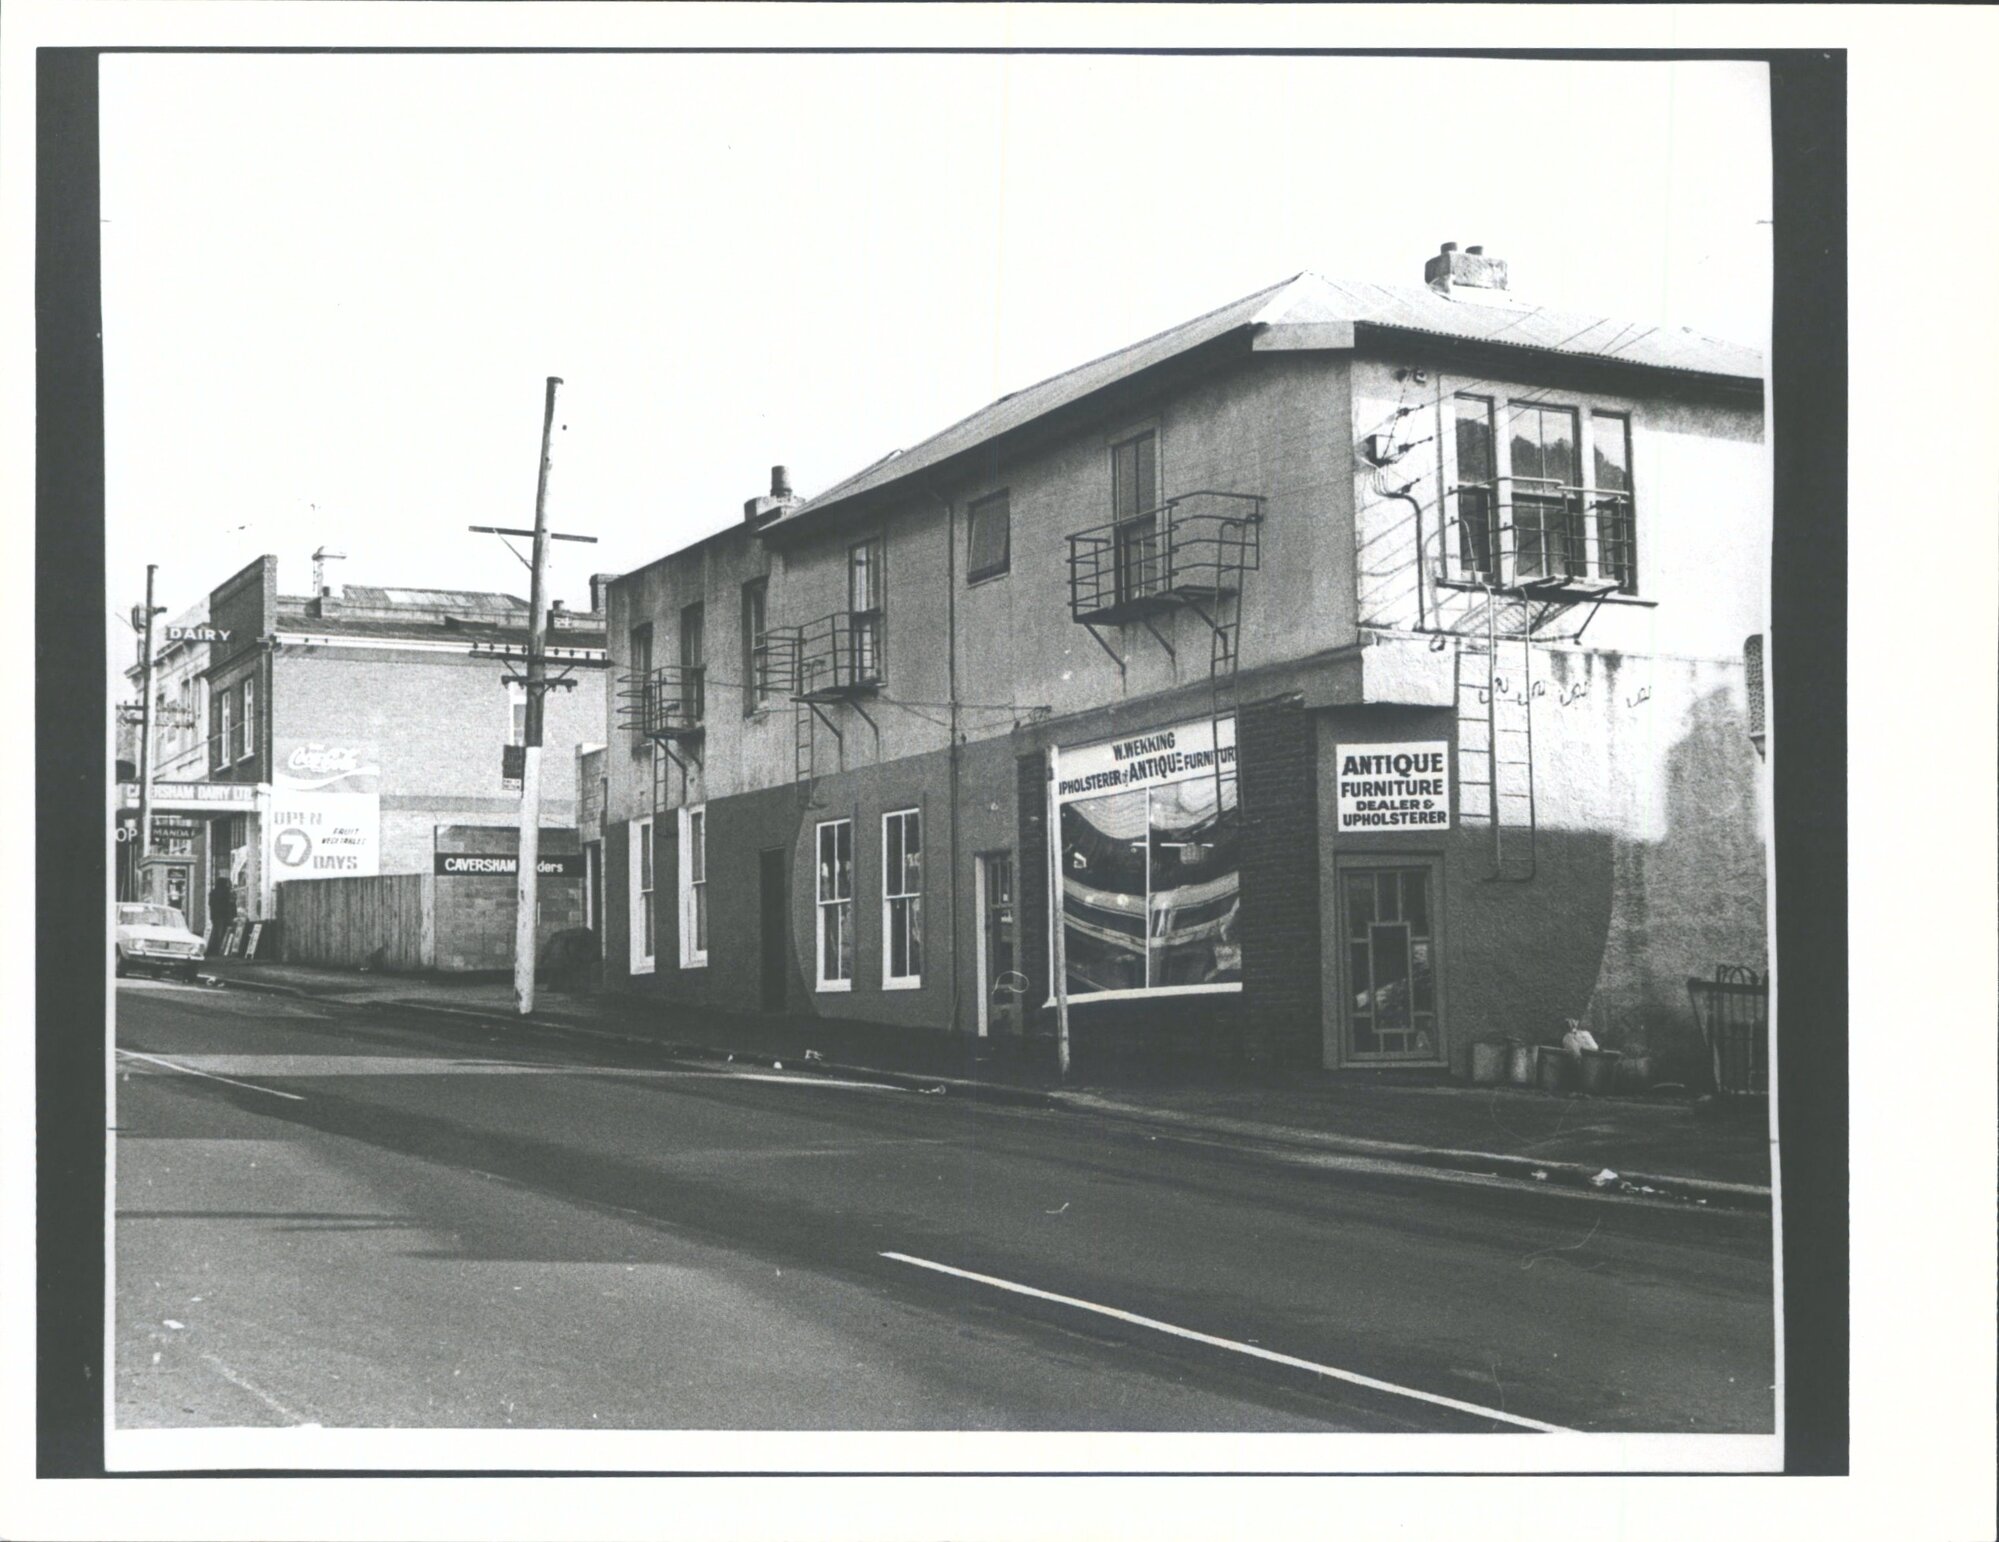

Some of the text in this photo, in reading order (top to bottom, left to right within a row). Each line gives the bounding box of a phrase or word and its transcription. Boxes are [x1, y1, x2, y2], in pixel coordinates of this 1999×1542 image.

[170, 628, 231, 641] DAIRY
[1129, 752, 1184, 779] ANTIQUE
[1184, 746, 1236, 771] FURNITUR
[1342, 753, 1443, 778] ANTIQUE
[1341, 779, 1443, 798] FURNITURE
[1356, 799, 1435, 811] DEALER &
[274, 811, 322, 825] OPEN
[1343, 811, 1446, 826] UPHOLSTERER
[280, 833, 307, 863] 7
[313, 855, 357, 869] DAYS
[445, 858, 517, 872] CAVERSHAM
